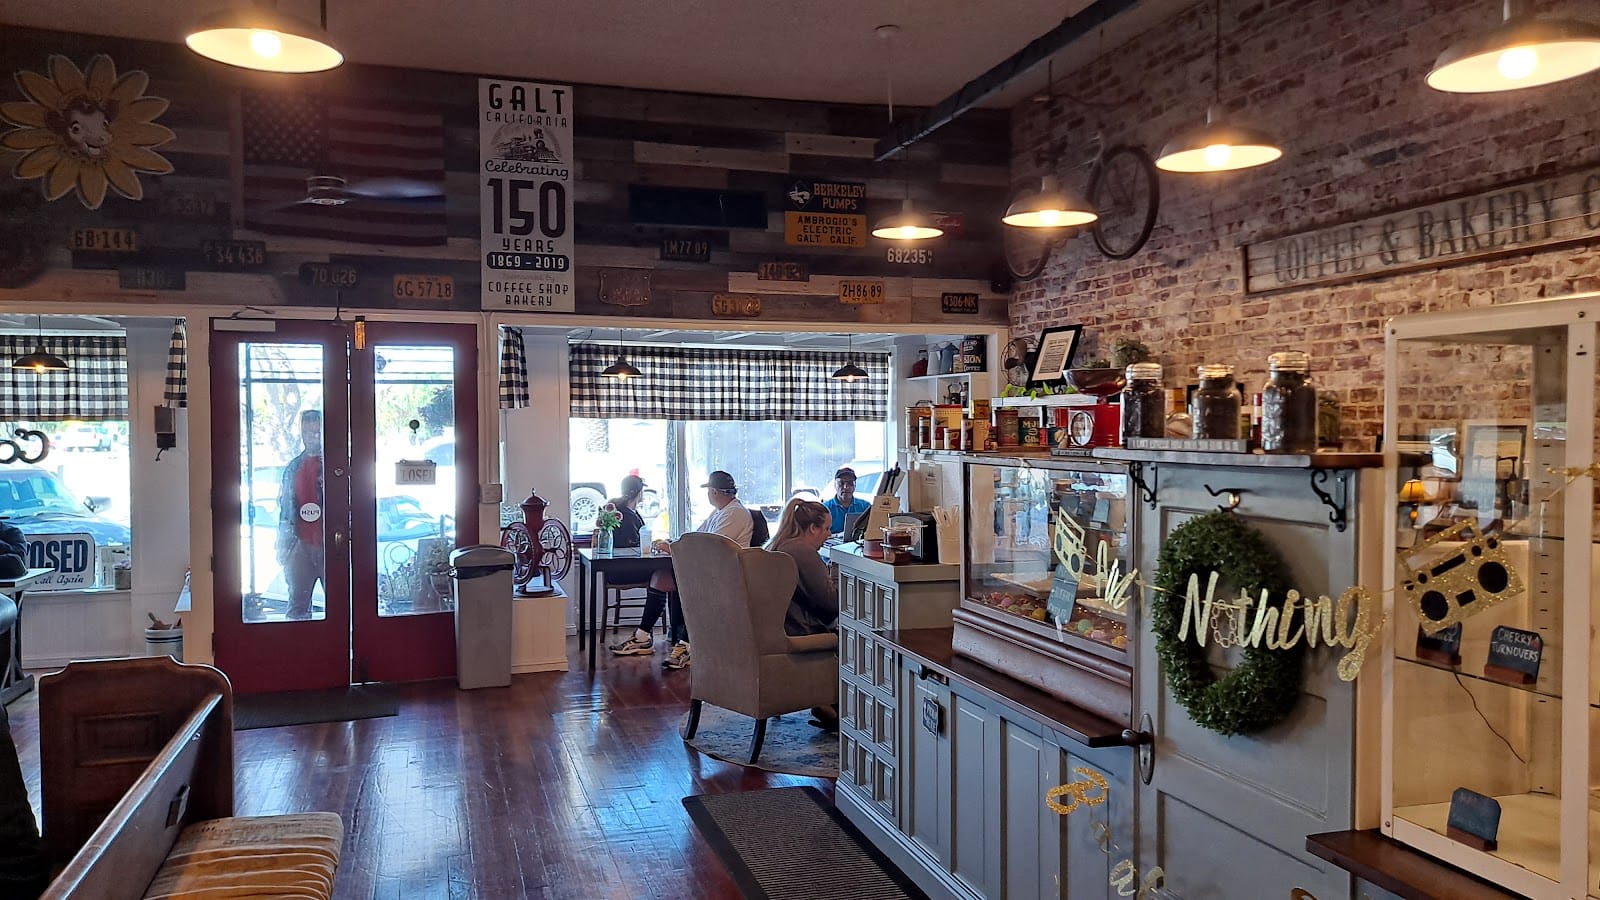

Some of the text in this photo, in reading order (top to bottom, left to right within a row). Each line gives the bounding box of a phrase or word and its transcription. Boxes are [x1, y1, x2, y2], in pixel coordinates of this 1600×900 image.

[488, 83, 565, 115] GALT
[486, 111, 567, 128] CALIFORNIA
[485, 159, 569, 180] Celebrating
[813, 183, 865, 198] BERKELEY
[487, 177, 566, 239] 150
[822, 197, 857, 210] PUMPS
[797, 215, 858, 227] AMBROGIO'S
[803, 225, 851, 236] ELECTRIC
[1273, 223, 1367, 284] COFFEE
[1378, 205, 1401, 266] &
[1415, 181, 1558, 261] BAKERY
[502, 238, 554, 253] YEARS
[887, 247, 927, 264] 68235
[488, 281, 569, 295] COFFEE SHOP
[505, 294, 552, 307] BAKERY
[26, 539, 88, 573] OSED
[56, 574, 85, 586] Again
[1177, 570, 1386, 682] Nothing
[1497, 628, 1533, 646] CHERRY
[1491, 640, 1539, 662] TURNOVERS
